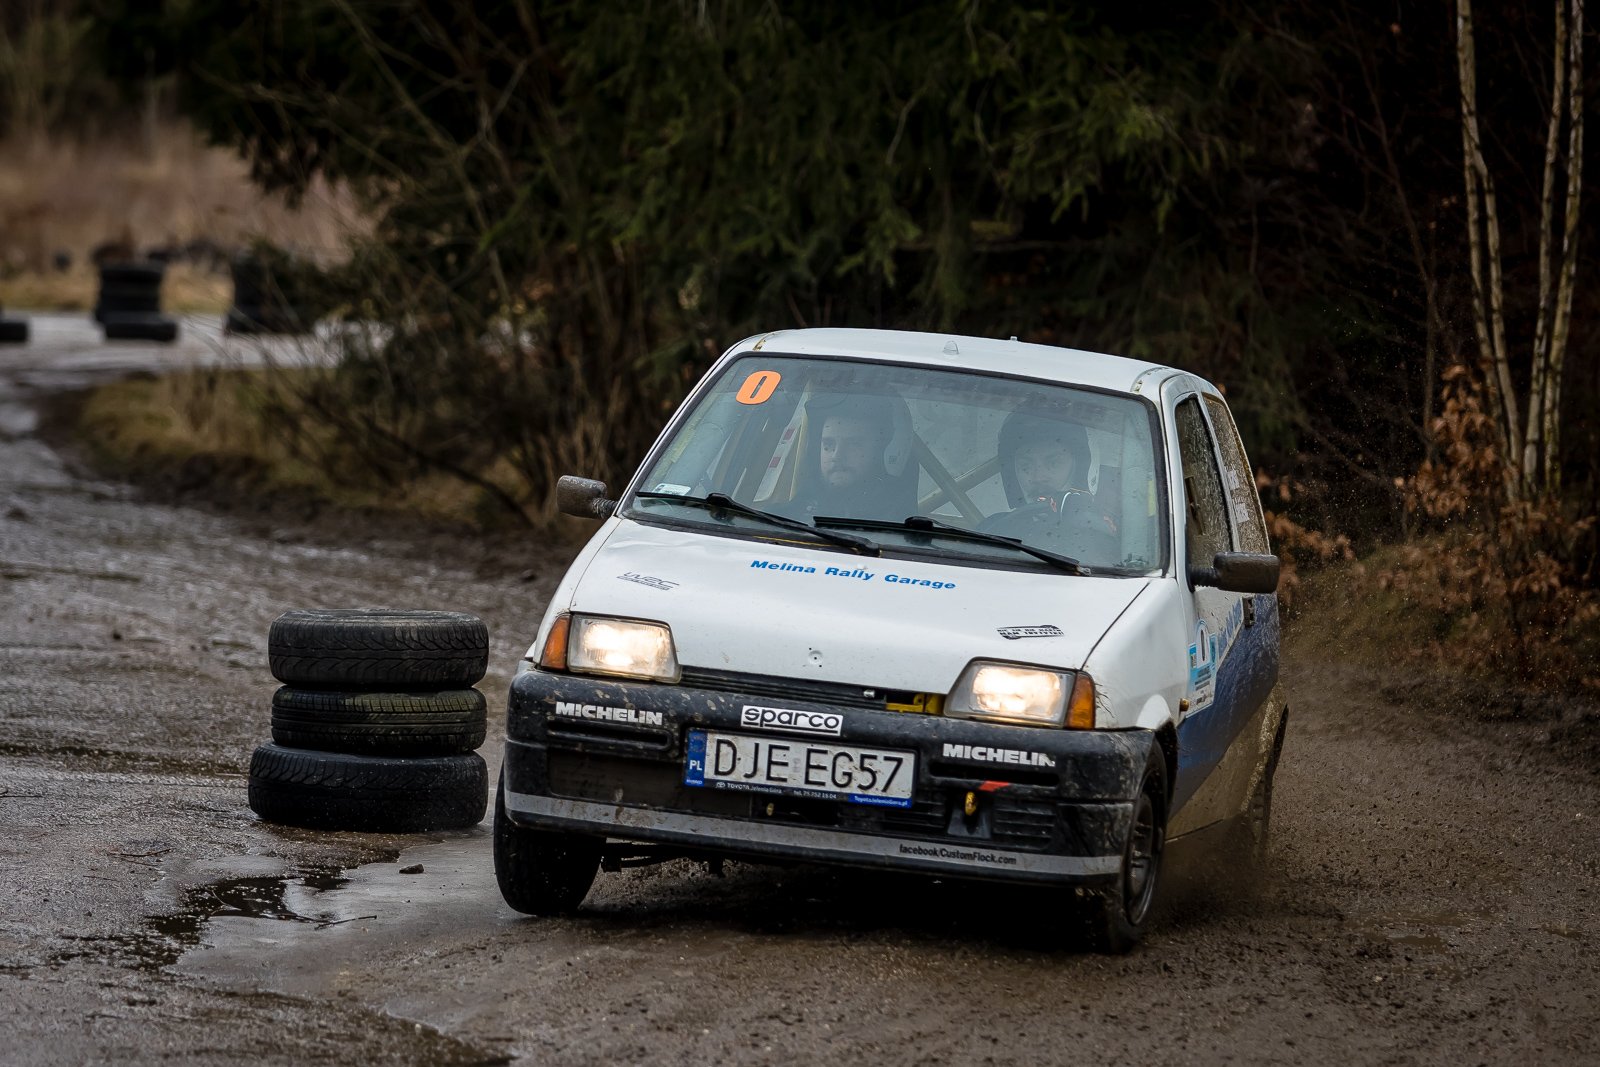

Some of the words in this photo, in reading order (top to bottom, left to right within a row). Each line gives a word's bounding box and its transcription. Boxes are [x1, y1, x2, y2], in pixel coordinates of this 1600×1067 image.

[736, 370, 782, 406] 0
[750, 560, 816, 574] Melina
[824, 566, 875, 581] Rally
[884, 574, 957, 590] Garage
[555, 701, 663, 726] MICHELIN
[743, 705, 840, 730] sparco
[689, 759, 703, 772] PL
[713, 738, 791, 783] DJE
[804, 747, 904, 793] EG57
[726, 782, 750, 791] TOYOTA
